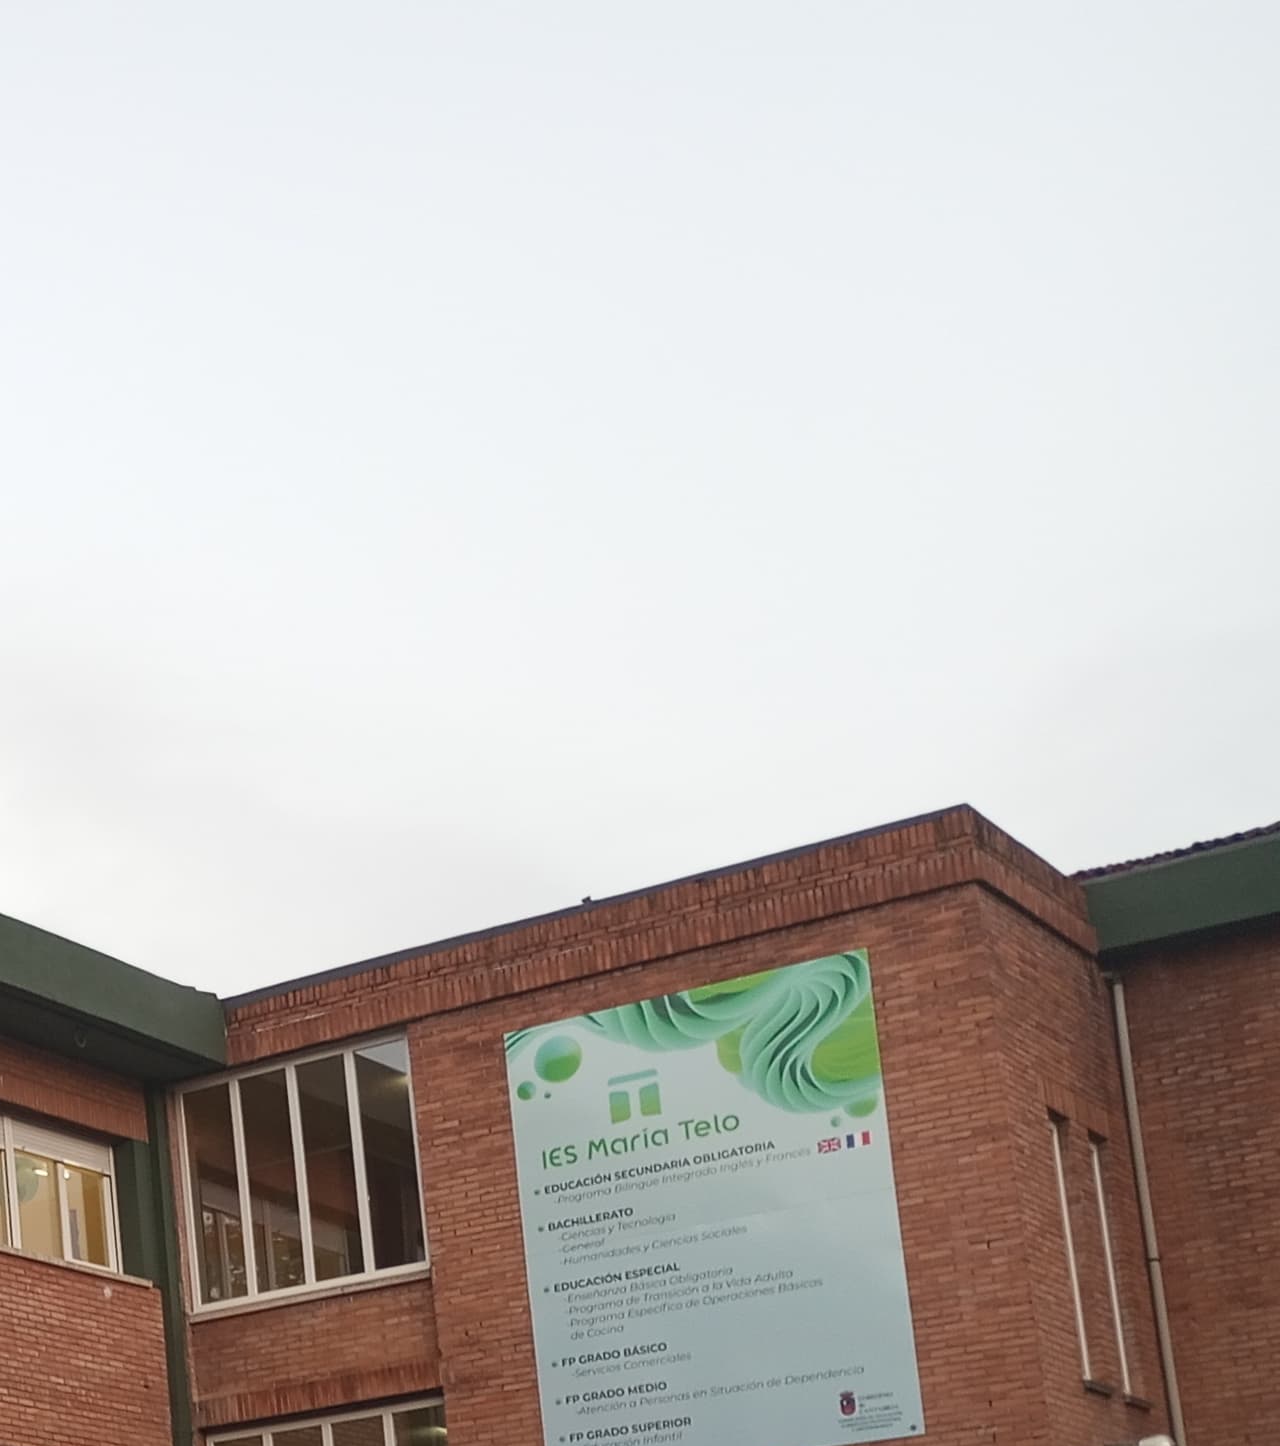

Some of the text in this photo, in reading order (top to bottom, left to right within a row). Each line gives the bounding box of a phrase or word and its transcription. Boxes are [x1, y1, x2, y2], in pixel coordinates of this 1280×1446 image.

[542, 1114, 740, 1170] IES María Telo
[544, 1140, 776, 1195] EDUCACIÓN SECUNDARIA OBLIGATORIA
[548, 1207, 634, 1232] BACHILLERATO
[554, 1262, 681, 1293] EDUCACIÓN ESPECIAL
[561, 1342, 667, 1368] FP GRADO BÁSICO
[565, 1381, 668, 1405] FP GRADO MEDIO
[569, 1417, 692, 1443] FP GRADO SUPERIOR
